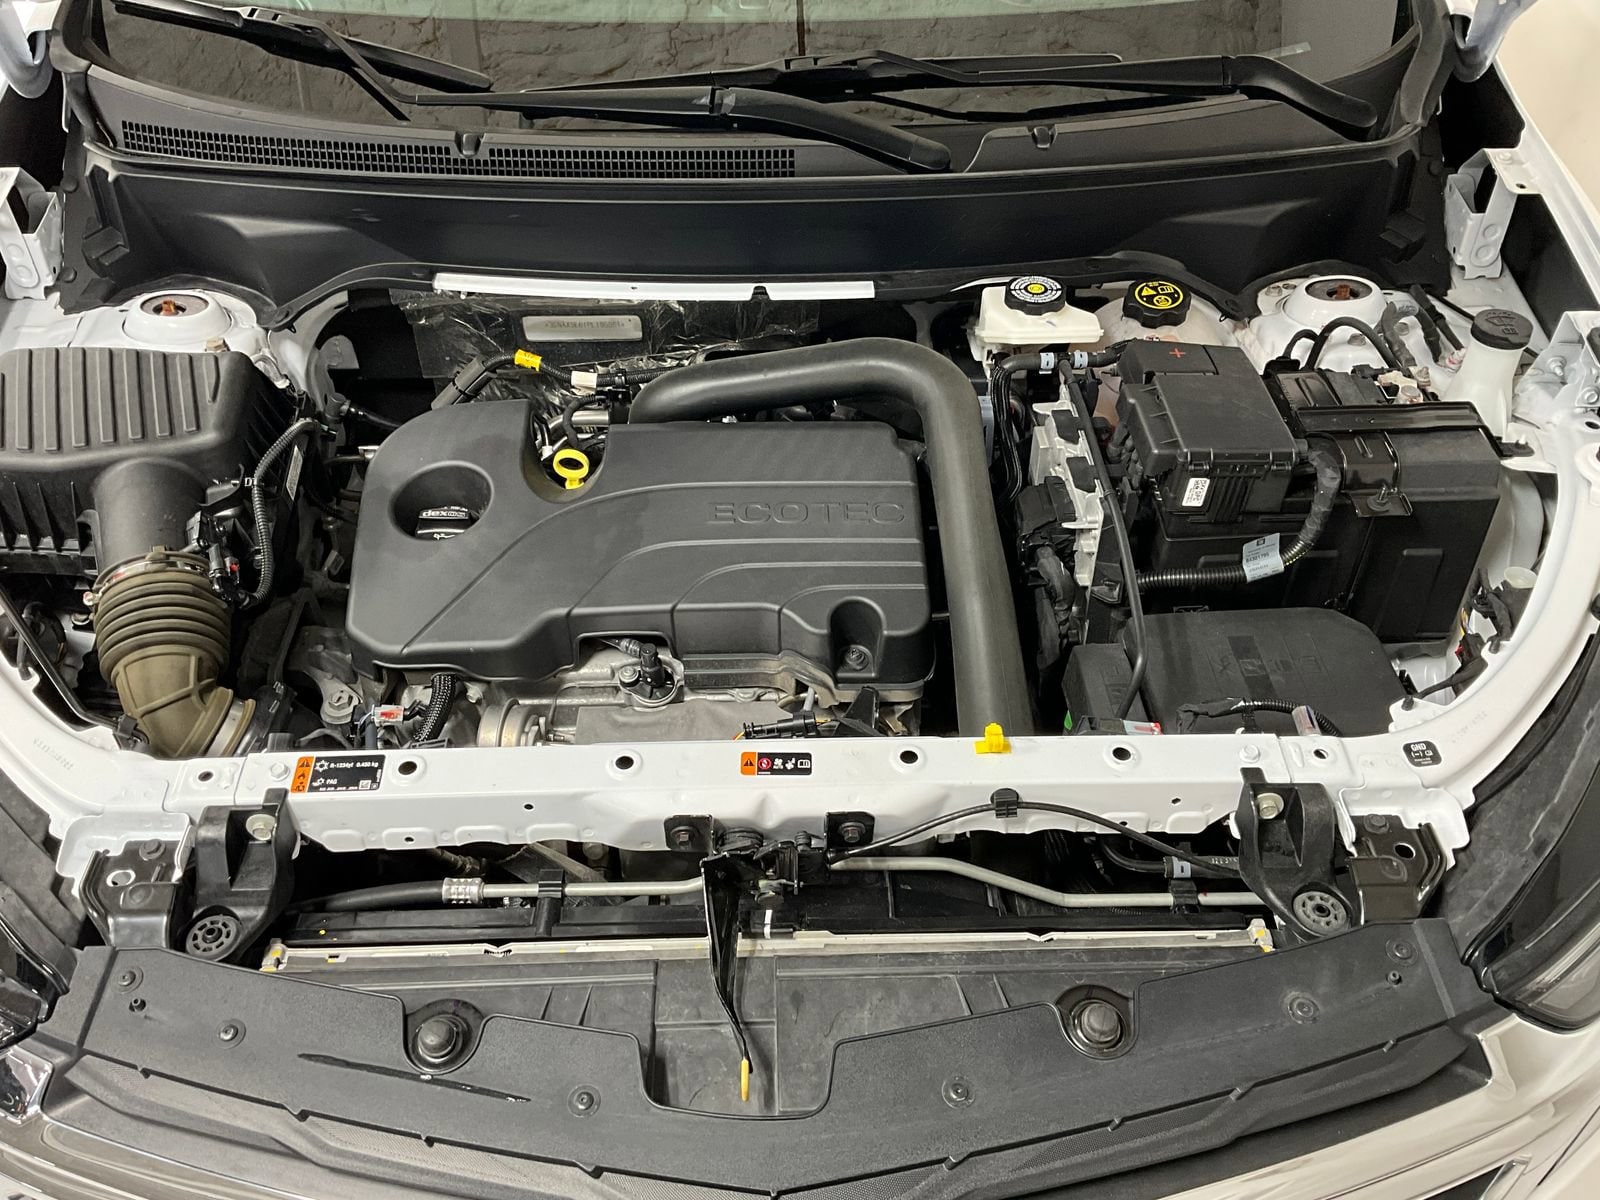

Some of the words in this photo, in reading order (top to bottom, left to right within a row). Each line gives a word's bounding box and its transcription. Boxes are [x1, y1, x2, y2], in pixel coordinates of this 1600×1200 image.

[422, 510, 466, 518] dexos
[706, 502, 905, 524] ECOTEC
[1410, 743, 1427, 751] GND
